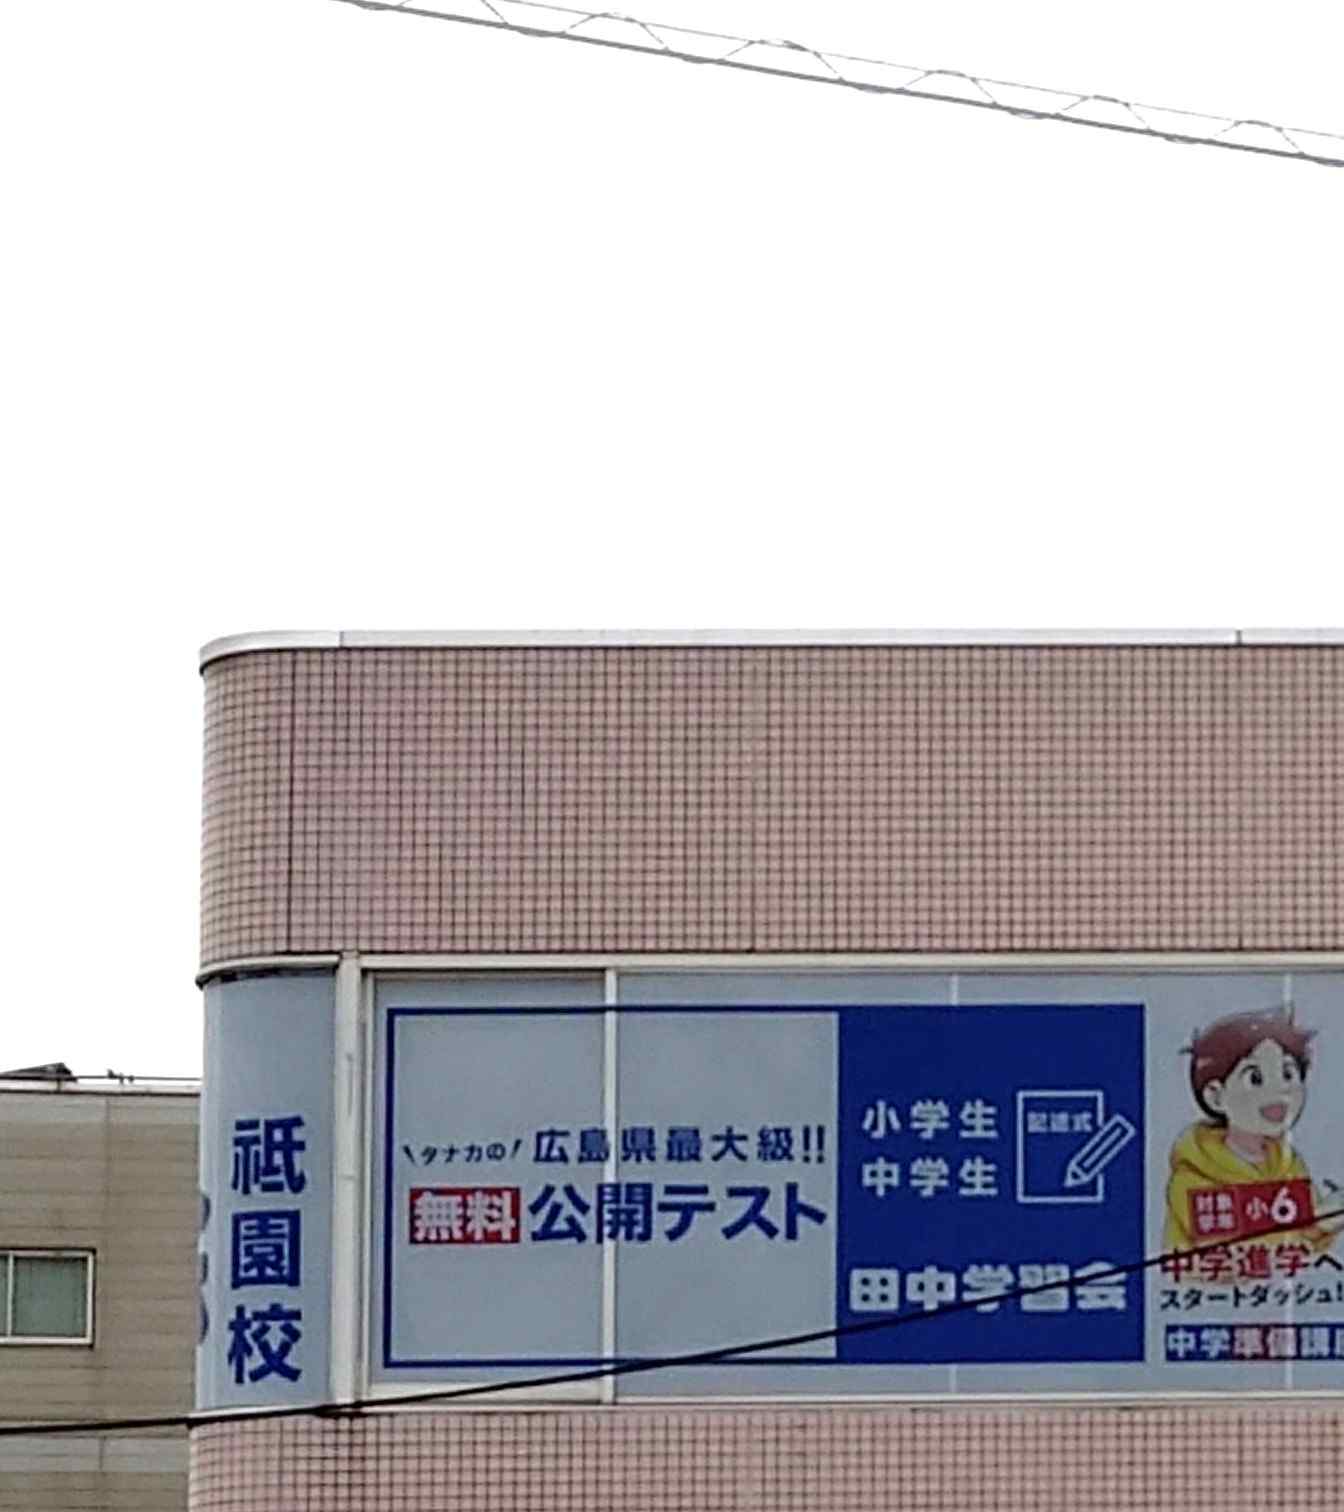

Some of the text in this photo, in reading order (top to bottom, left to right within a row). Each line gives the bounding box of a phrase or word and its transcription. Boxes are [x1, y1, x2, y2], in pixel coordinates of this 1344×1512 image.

[862, 1099, 998, 1140] 小学生
[532, 1127, 826, 1165] 広島県最大級!!
[862, 1157, 998, 1197] 中学生
[414, 1182, 828, 1245] 無料 公開テスト
[850, 1261, 1127, 1313] 田中学習会
